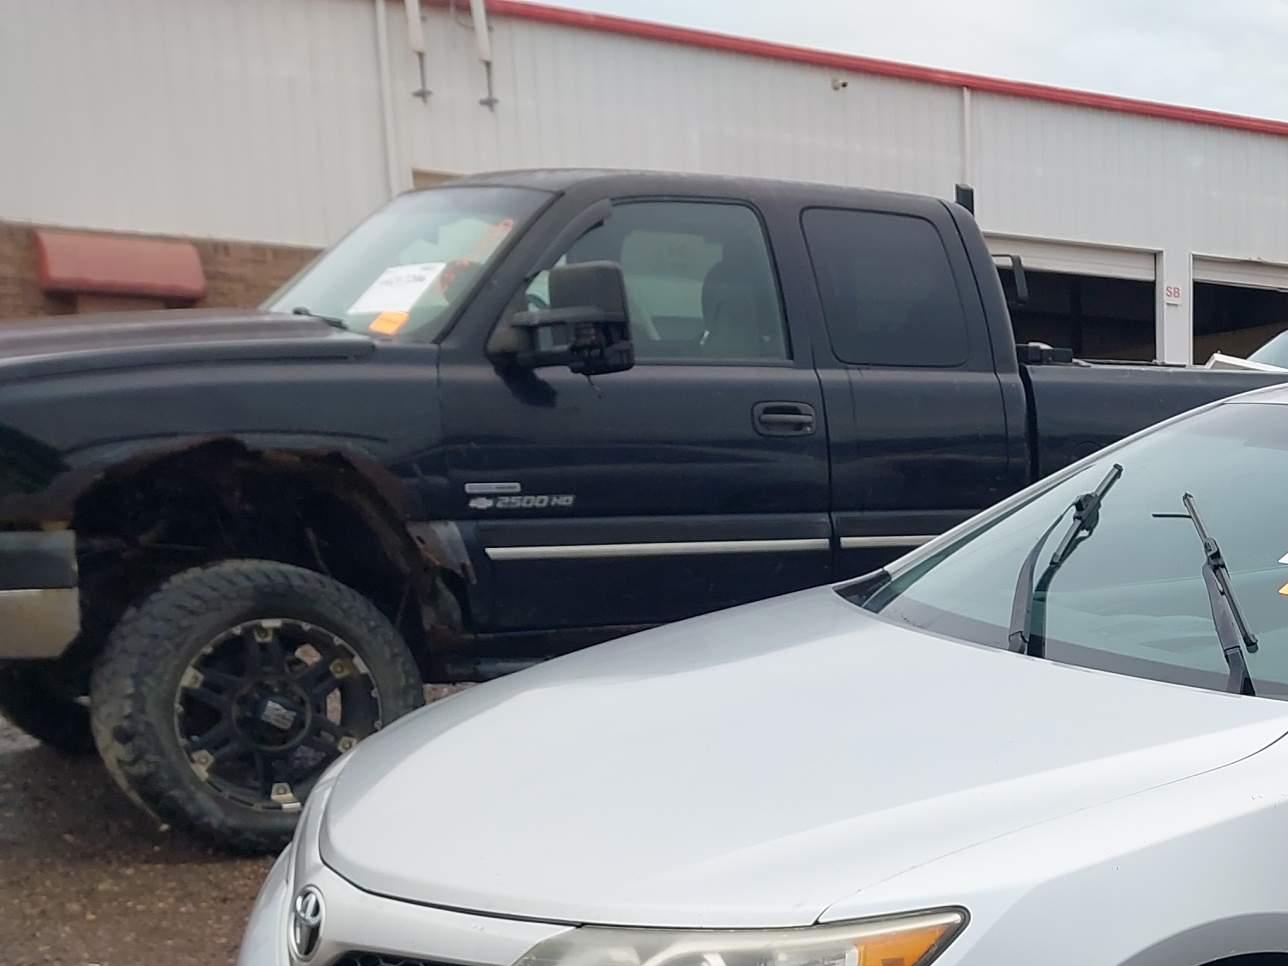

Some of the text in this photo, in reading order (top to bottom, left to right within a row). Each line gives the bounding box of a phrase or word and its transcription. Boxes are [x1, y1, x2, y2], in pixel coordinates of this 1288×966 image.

[1166, 286, 1180, 299] SB
[496, 495, 575, 508] 2500 HD
